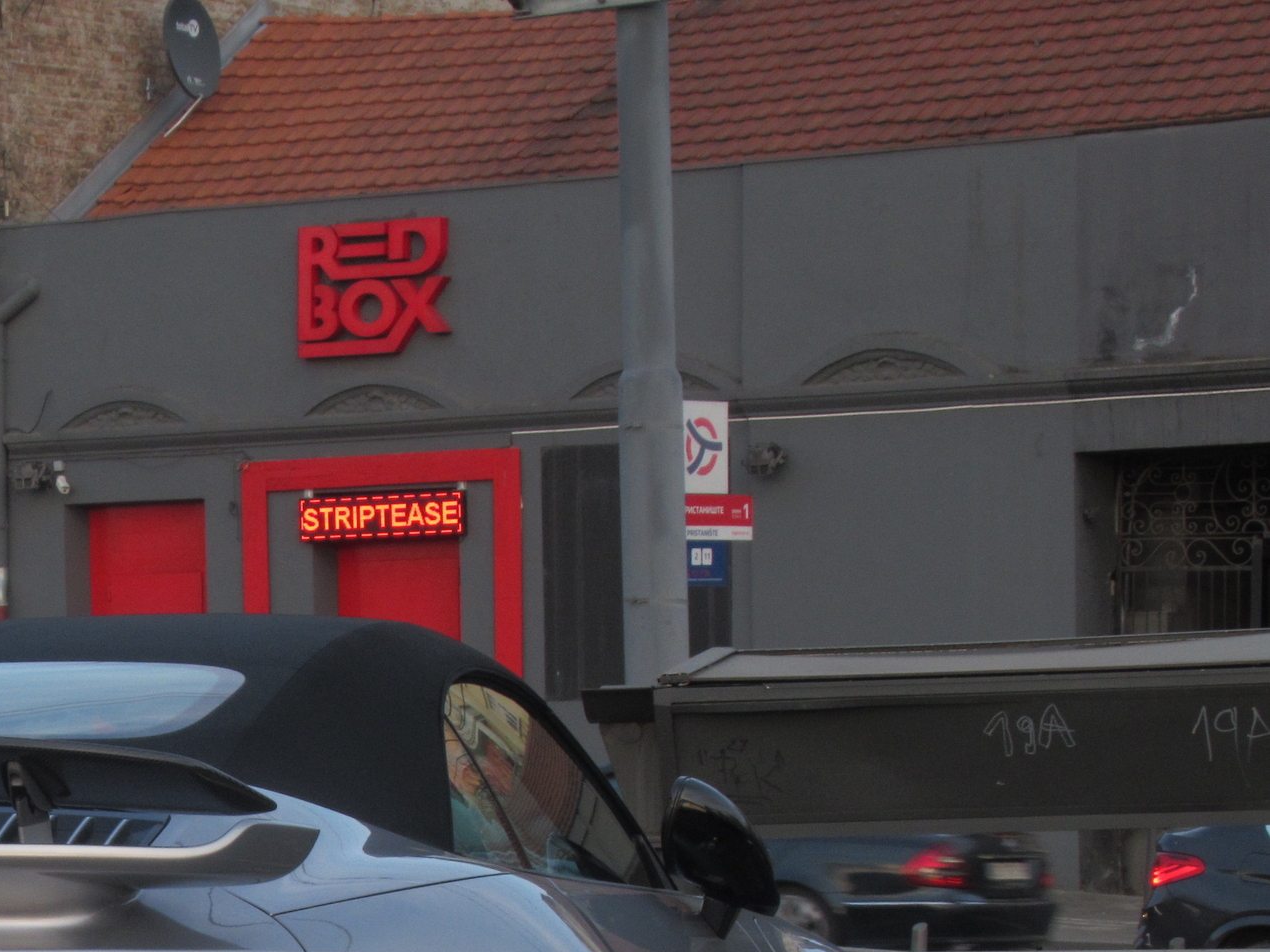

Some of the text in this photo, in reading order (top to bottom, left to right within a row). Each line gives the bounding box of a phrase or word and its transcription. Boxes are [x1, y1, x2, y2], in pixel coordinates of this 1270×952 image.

[298, 216, 449, 280] RED
[298, 275, 452, 358] BOX
[302, 501, 458, 531] STRIPTEASE
